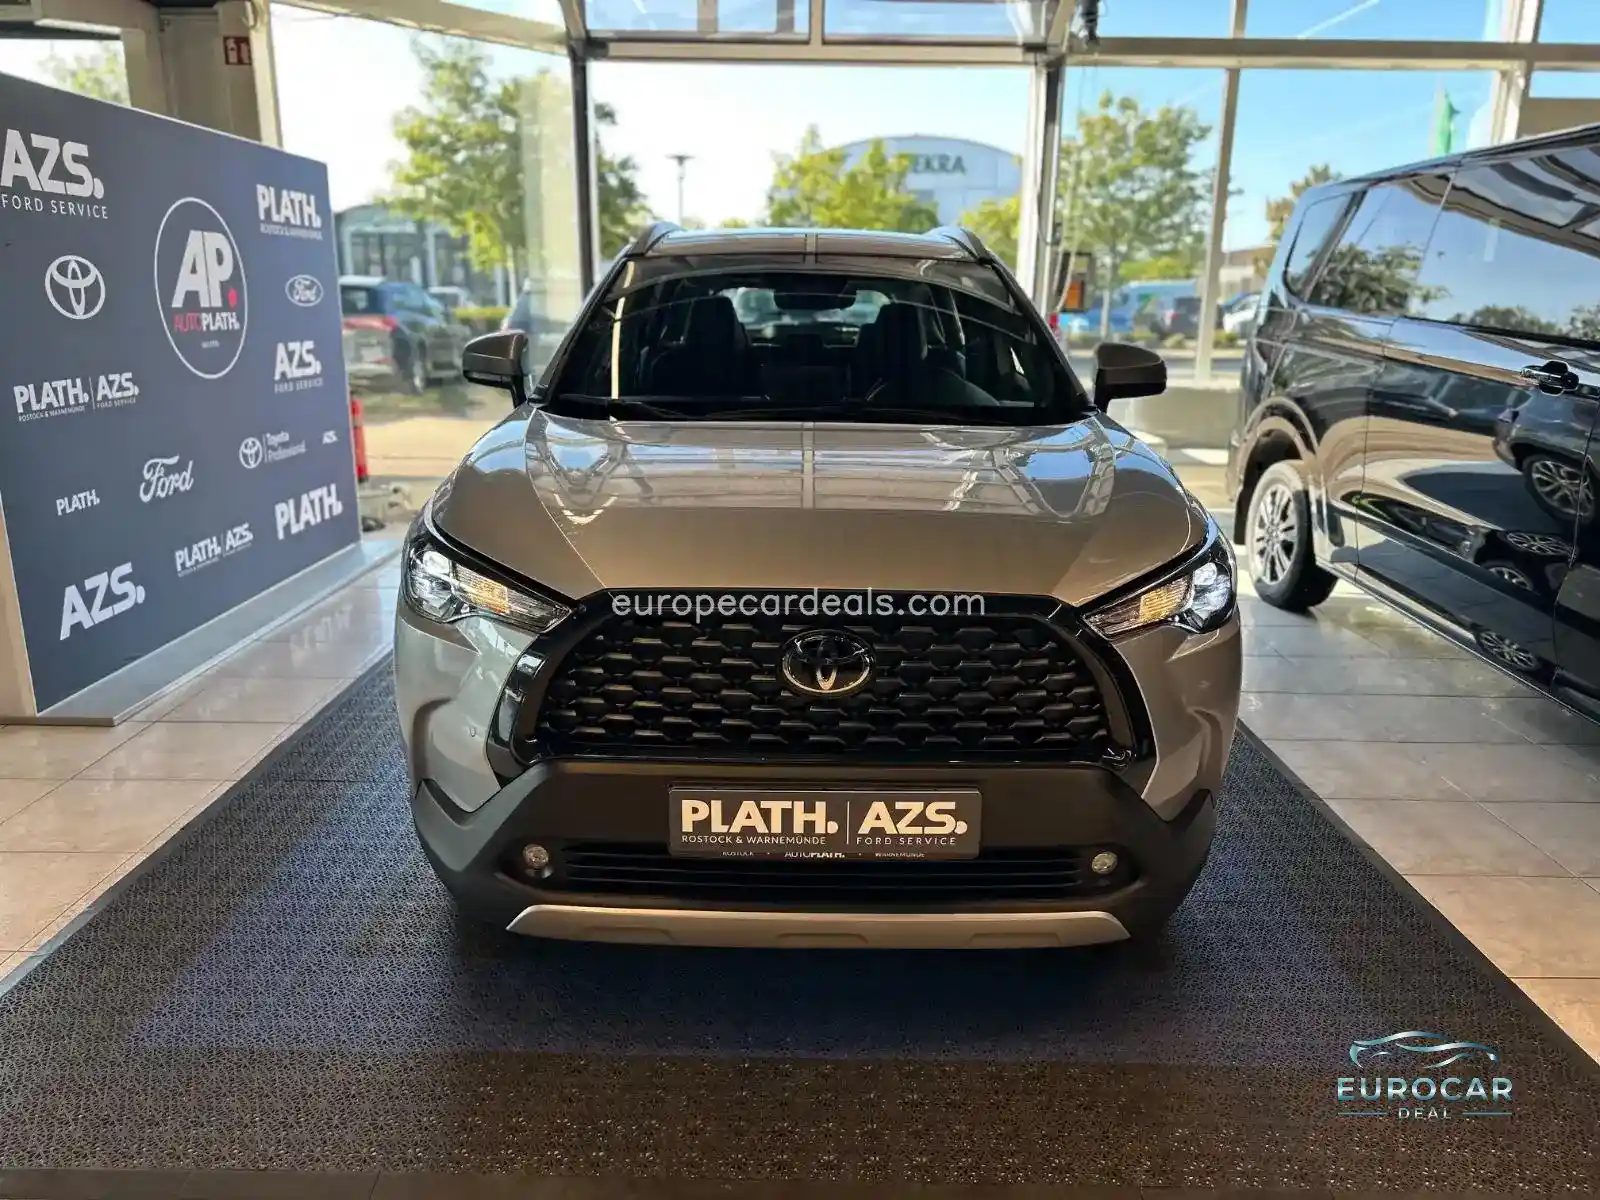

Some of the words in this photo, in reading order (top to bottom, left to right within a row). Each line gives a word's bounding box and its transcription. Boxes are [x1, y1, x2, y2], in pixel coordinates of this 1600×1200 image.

[0, 128, 105, 200] AZS.
[911, 153, 967, 176] EKRA
[1, 193, 44, 213] FORD
[50, 199, 109, 220] SERVICE
[256, 183, 323, 229] PLATH.
[171, 229, 238, 309] AP.
[173, 311, 240, 333] AUTOPLATH.
[274, 340, 322, 381] AZS.
[13, 378, 90, 414] PLATH.
[96, 371, 140, 402] AZS.
[140, 454, 194, 502] Ford
[56, 489, 101, 516] PLATH.
[274, 483, 344, 540] PLATH.
[175, 535, 222, 573] PLATH.
[225, 522, 254, 551] AZS.
[59, 560, 146, 641] AZS.
[681, 799, 840, 834] PLATH.
[857, 800, 968, 835] AZS.
[681, 835, 733, 844] ROSTOCK
[735, 835, 744, 844] &
[856, 837, 892, 846] FORD
[898, 836, 957, 846] SERVICE
